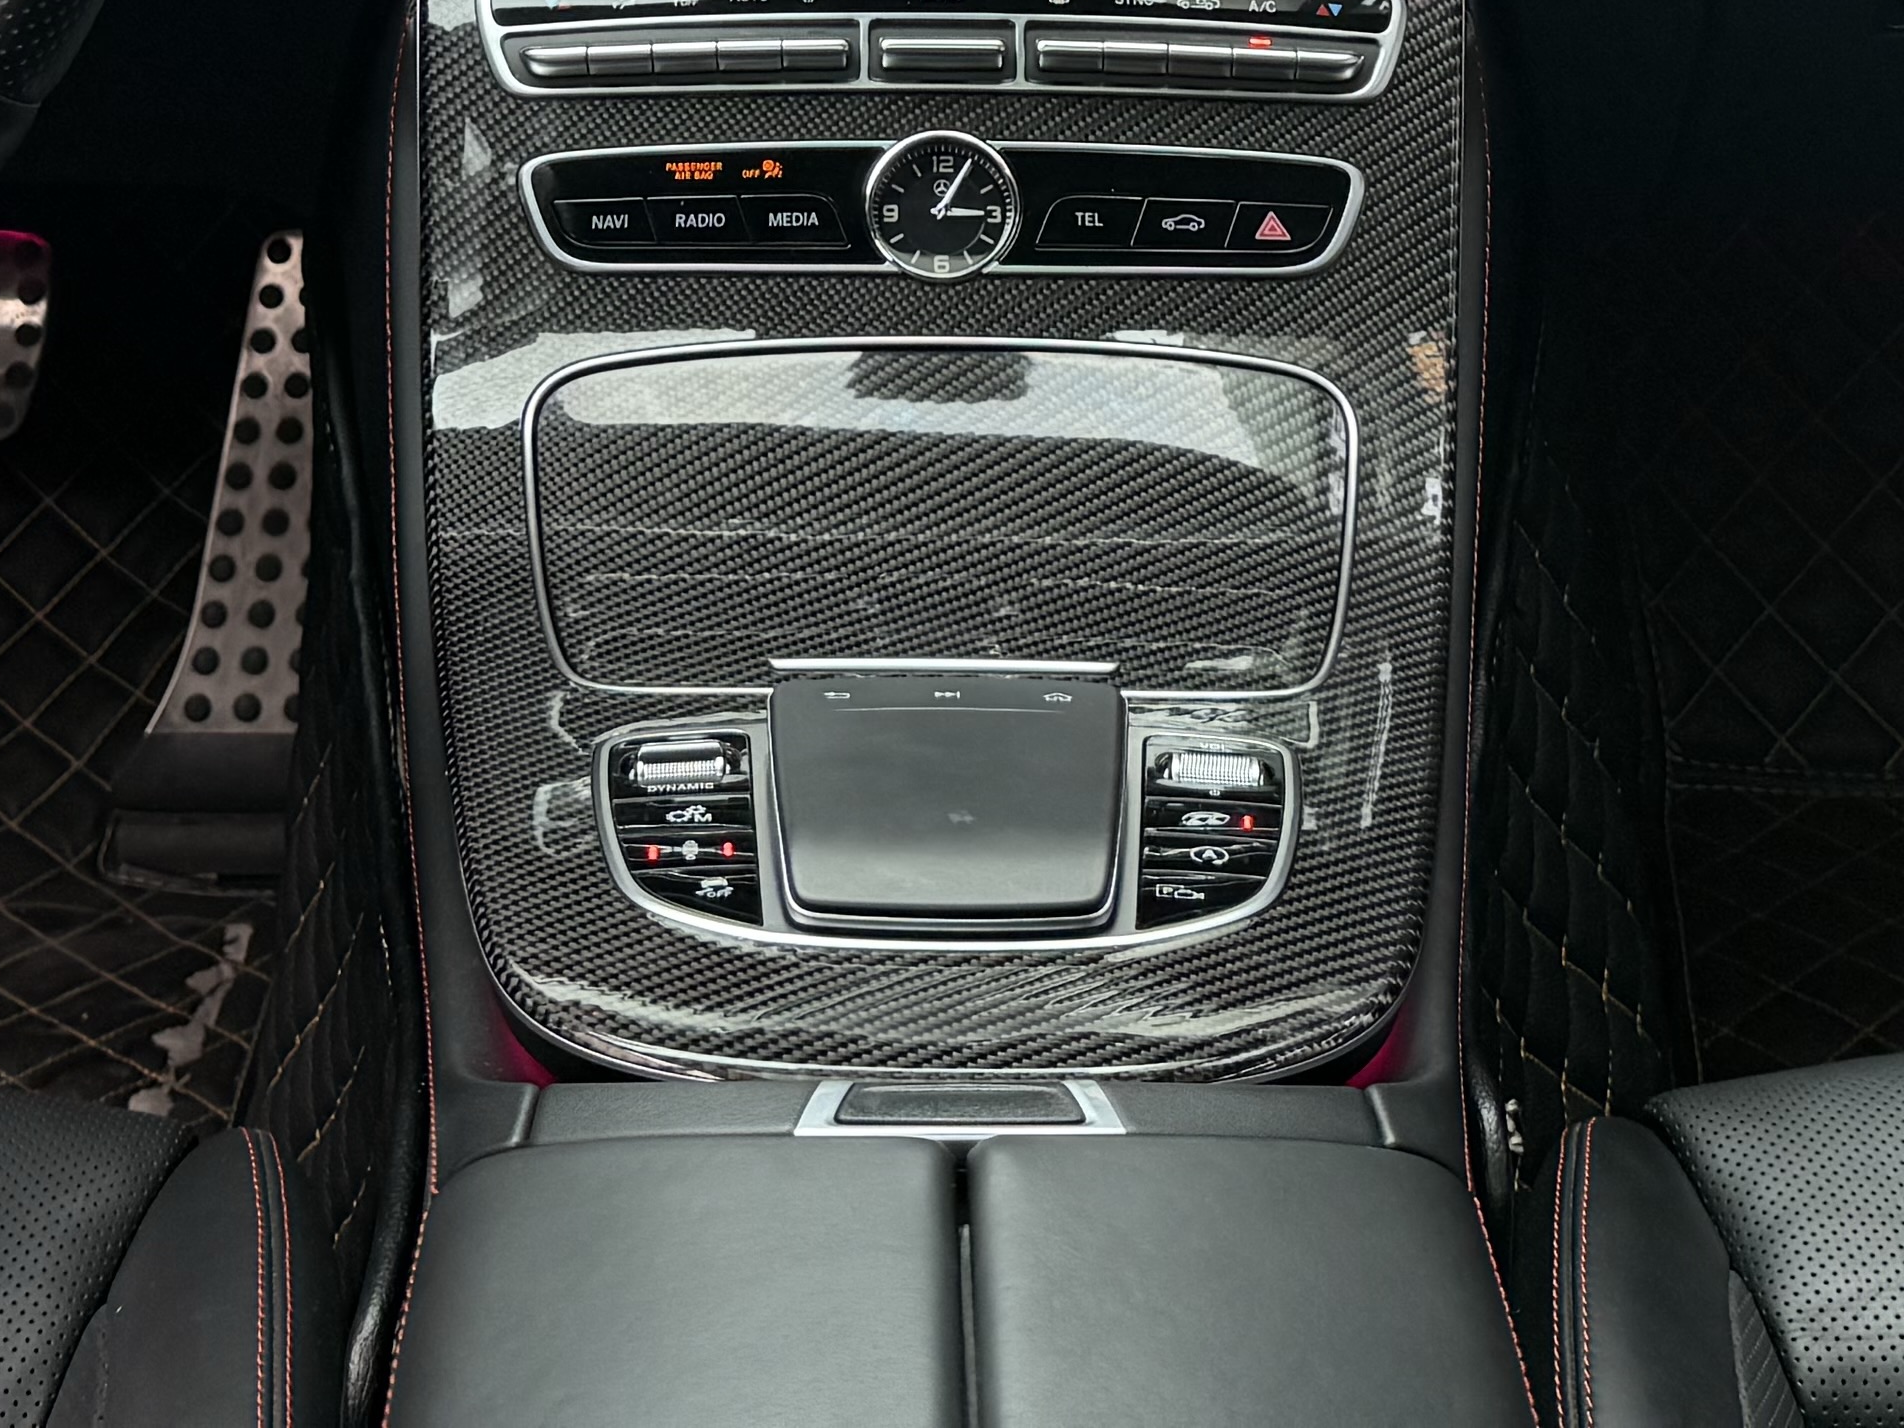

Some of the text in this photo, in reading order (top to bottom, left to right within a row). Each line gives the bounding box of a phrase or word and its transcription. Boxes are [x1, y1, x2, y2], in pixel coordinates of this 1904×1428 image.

[1248, 0, 1277, 13] A/C
[665, 162, 723, 172] PASSENGER
[932, 156, 955, 173] 12
[742, 169, 761, 179] OFF
[675, 212, 726, 228] RADIO
[768, 211, 820, 227] MEDIA
[882, 204, 899, 223] 9
[986, 205, 1002, 223] 3
[1074, 212, 1104, 227] TEL
[591, 214, 629, 229] NAVI
[933, 255, 950, 273] 6
[647, 782, 715, 793] DYNAMIC
